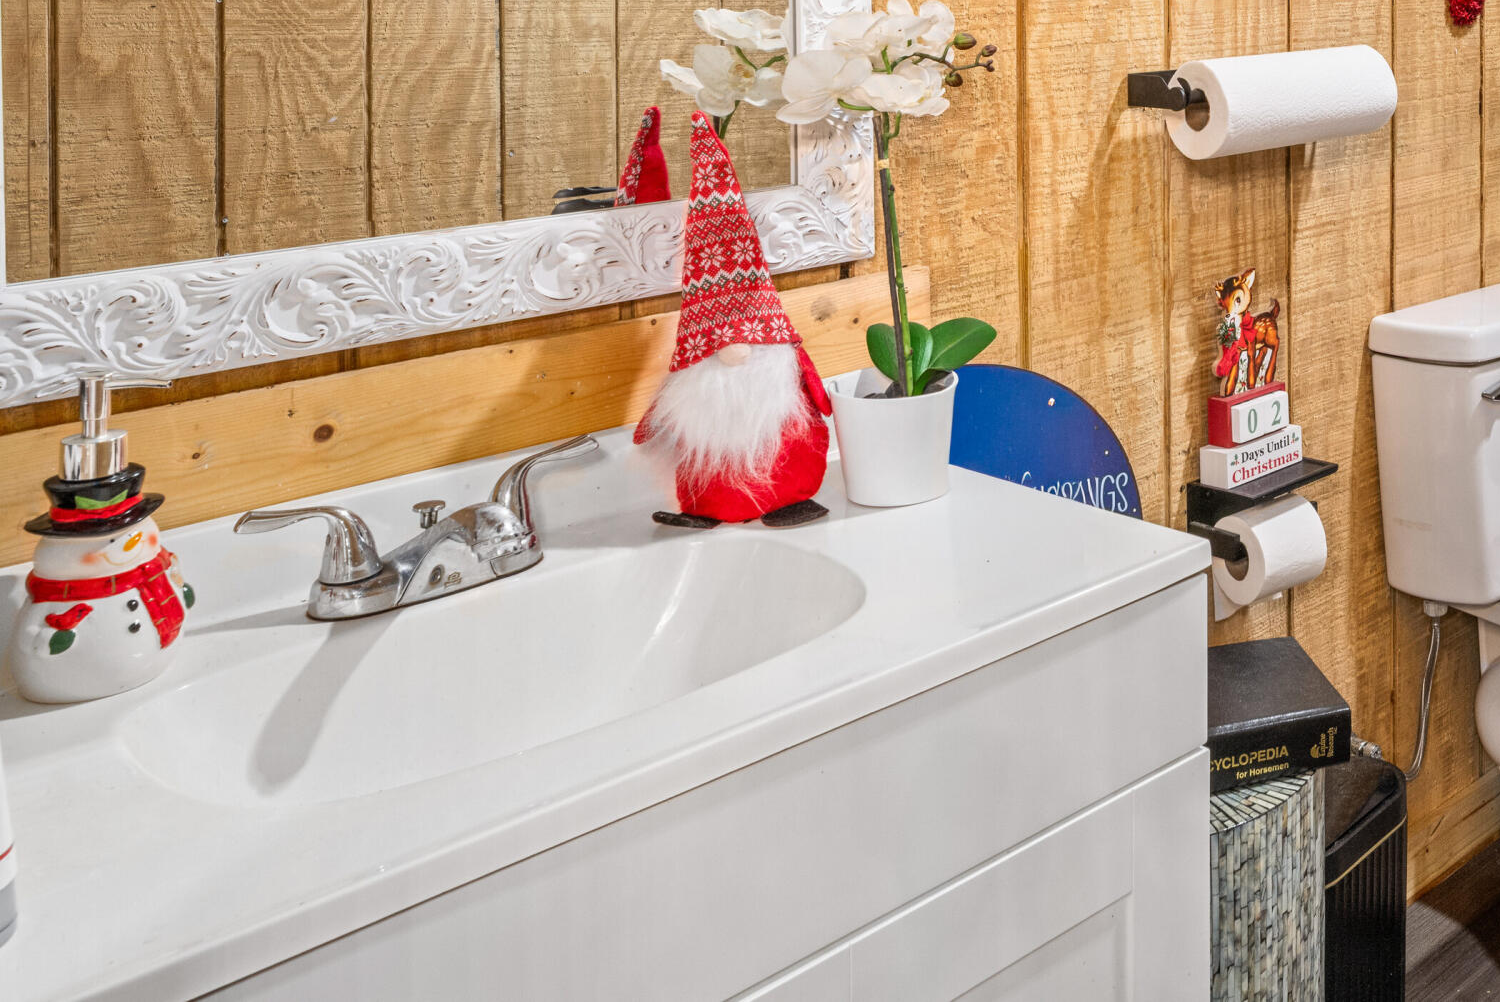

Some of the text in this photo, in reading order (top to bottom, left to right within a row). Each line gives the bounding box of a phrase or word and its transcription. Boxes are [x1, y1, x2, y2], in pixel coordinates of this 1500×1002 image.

[1241, 434, 1290, 464] Days Until
[1232, 449, 1300, 484] Christmas
[1236, 762, 1290, 780] for Horsemen
